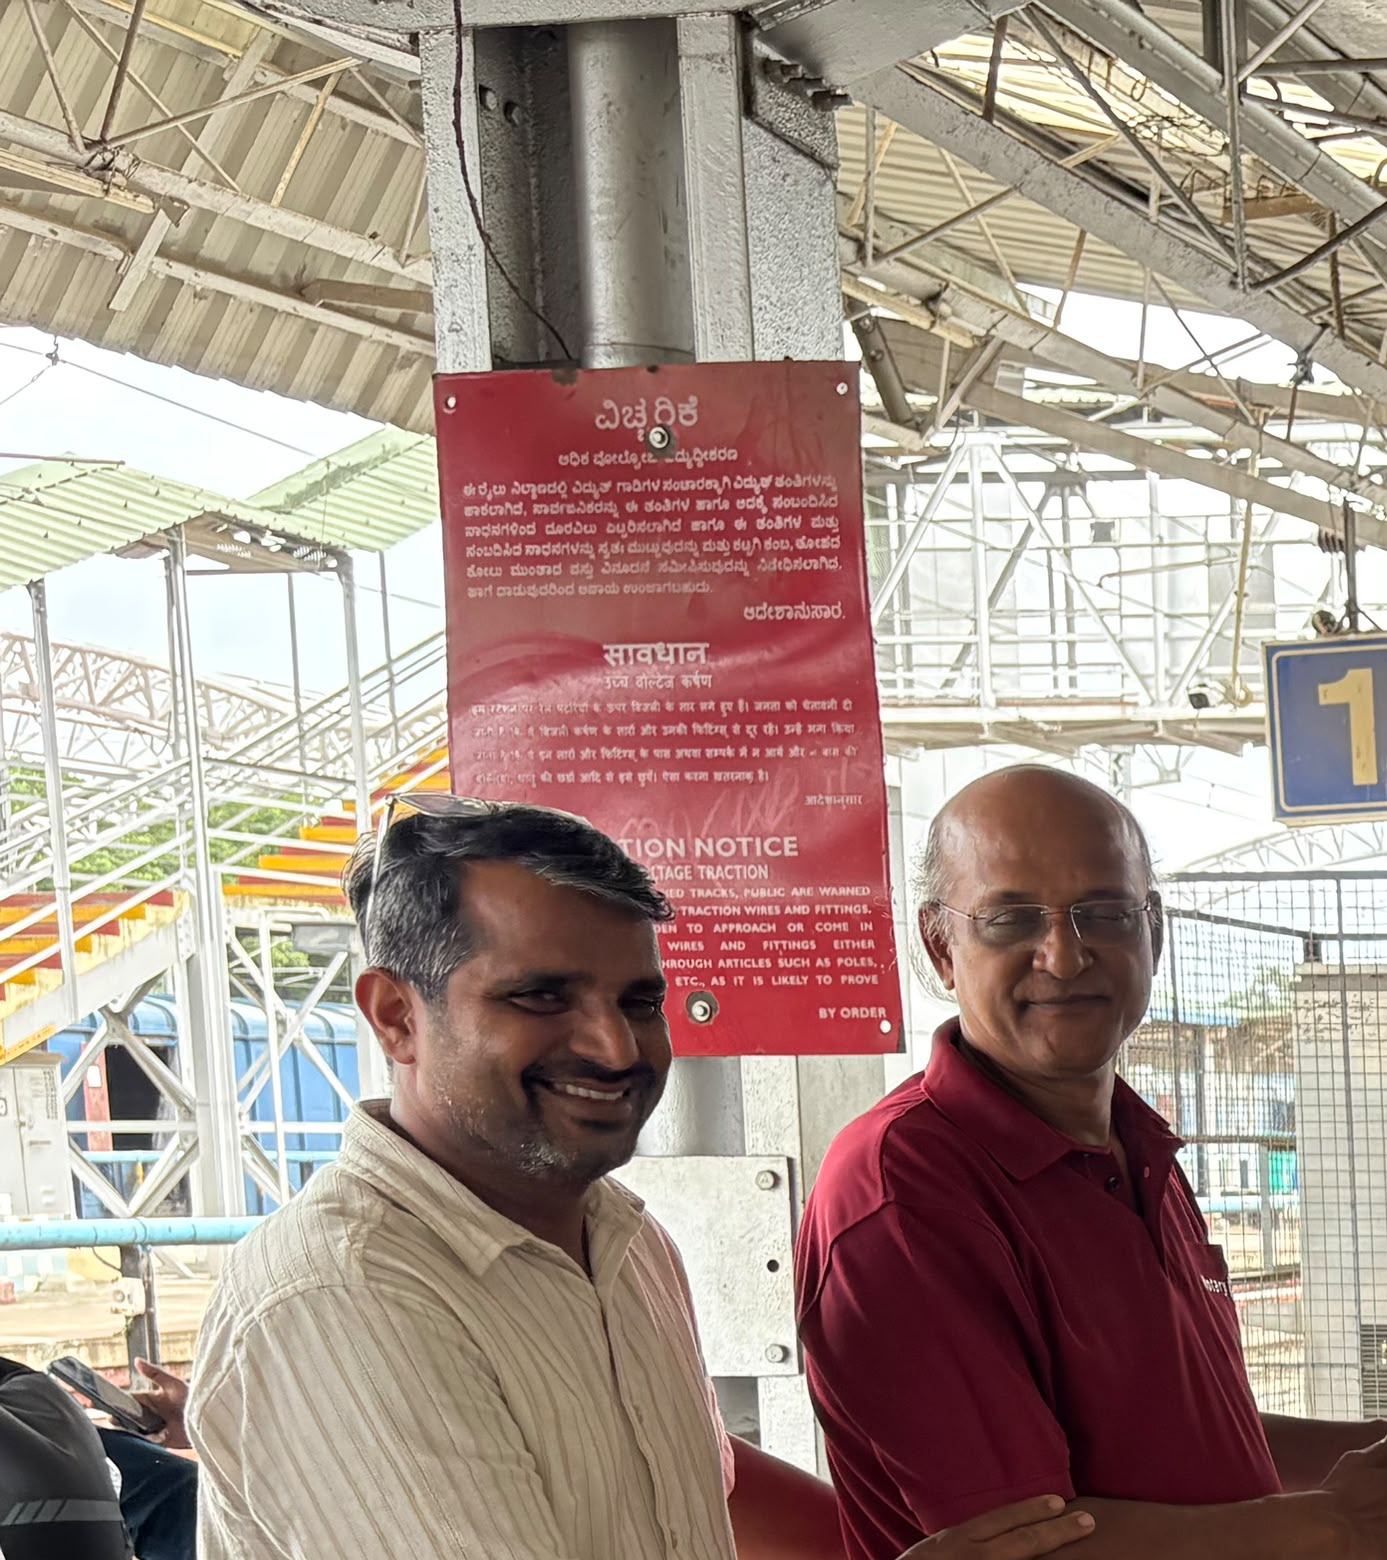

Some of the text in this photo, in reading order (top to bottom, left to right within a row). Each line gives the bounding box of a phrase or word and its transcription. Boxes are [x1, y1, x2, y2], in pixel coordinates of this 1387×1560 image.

[602, 641, 710, 668] सावधान
[681, 670, 713, 690] कर्षण
[1317, 667, 1378, 787] 1
[694, 836, 799, 858] NOTICE
[698, 864, 770, 881] TRACTION
[690, 885, 872, 900] TRACKS, PUBLIC ARE WARNED
[680, 903, 873, 917] TRACTION WIRES AND FITTINGS.
[687, 923, 704, 935] TO
[713, 922, 777, 934] APPROACH
[787, 922, 805, 933] OR
[815, 921, 850, 933] COME
[860, 921, 873, 932] IN
[667, 939, 876, 952] WIRES AND FITTINGS EITHER
[718, 957, 772, 969] ARTICLES
[777, 956, 810, 969] SUCH
[815, 956, 831, 968] AS
[836, 956, 877, 969] POLES,
[710, 975, 726, 987] AS
[733, 975, 745, 987] IT
[753, 975, 764, 987] IS
[771, 975, 809, 986] LIKELY
[815, 974, 833, 986] TO
[840, 974, 879, 985] PROVE
[818, 1006, 888, 1020] BY ORDER
